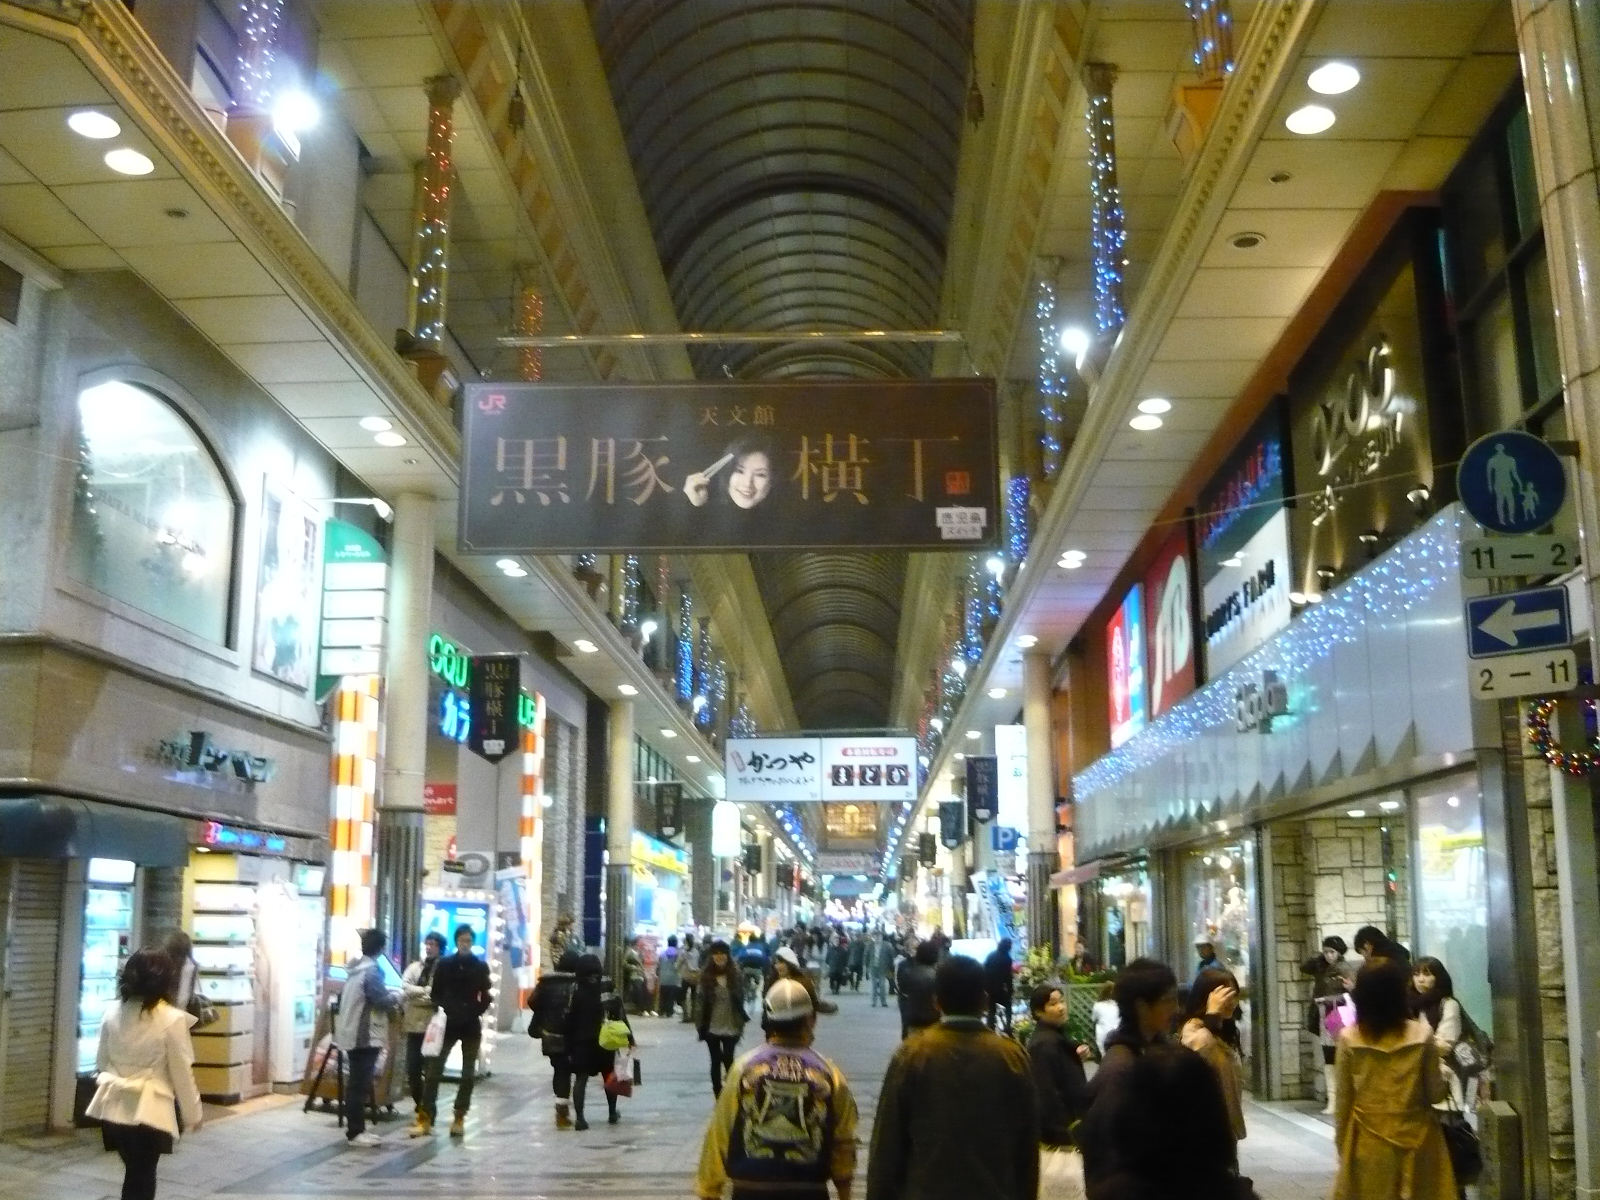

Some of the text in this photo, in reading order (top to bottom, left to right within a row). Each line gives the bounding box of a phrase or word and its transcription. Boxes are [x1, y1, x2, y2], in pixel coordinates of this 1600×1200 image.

[478, 394, 506, 410] JR
[491, 432, 960, 507] 黒豚 横丁
[998, 828, 1013, 848] P
